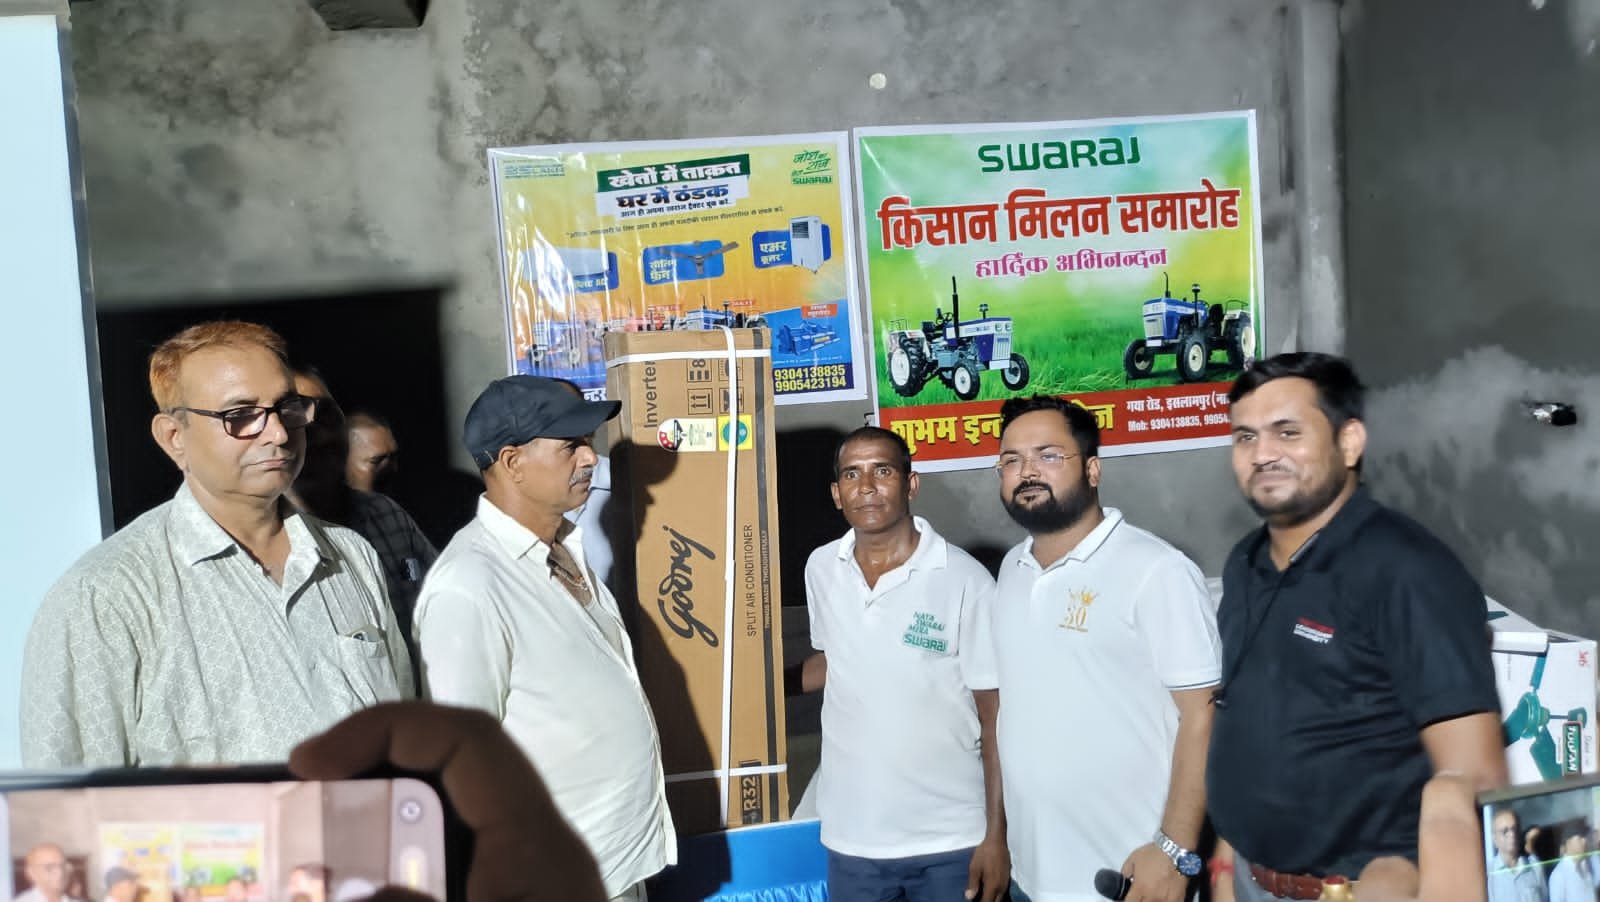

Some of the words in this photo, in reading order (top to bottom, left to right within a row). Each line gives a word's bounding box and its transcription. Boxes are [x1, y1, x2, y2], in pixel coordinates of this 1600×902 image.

[608, 166, 658, 188] खेतों
[659, 164, 679, 182] में
[616, 192, 648, 208] घर
[650, 185, 671, 204] में
[673, 183, 729, 202] ठंडक
[877, 196, 999, 249] किसान
[1003, 188, 1110, 241] मिलन
[1116, 179, 1240, 234] समारोह
[975, 252, 1049, 278] हार्दिक
[1055, 248, 1168, 272] अभिनन्दन
[774, 365, 846, 380] 9304138835
[775, 376, 847, 391] 9905423194
[1126, 400, 1145, 412] गया
[1128, 420, 1149, 432] Mob:
[743, 524, 755, 590] CONDITIONER
[657, 525, 719, 648] Godrej
[745, 592, 756, 608] AIR
[746, 611, 757, 637] SPLIT
[742, 776, 756, 811] R32
